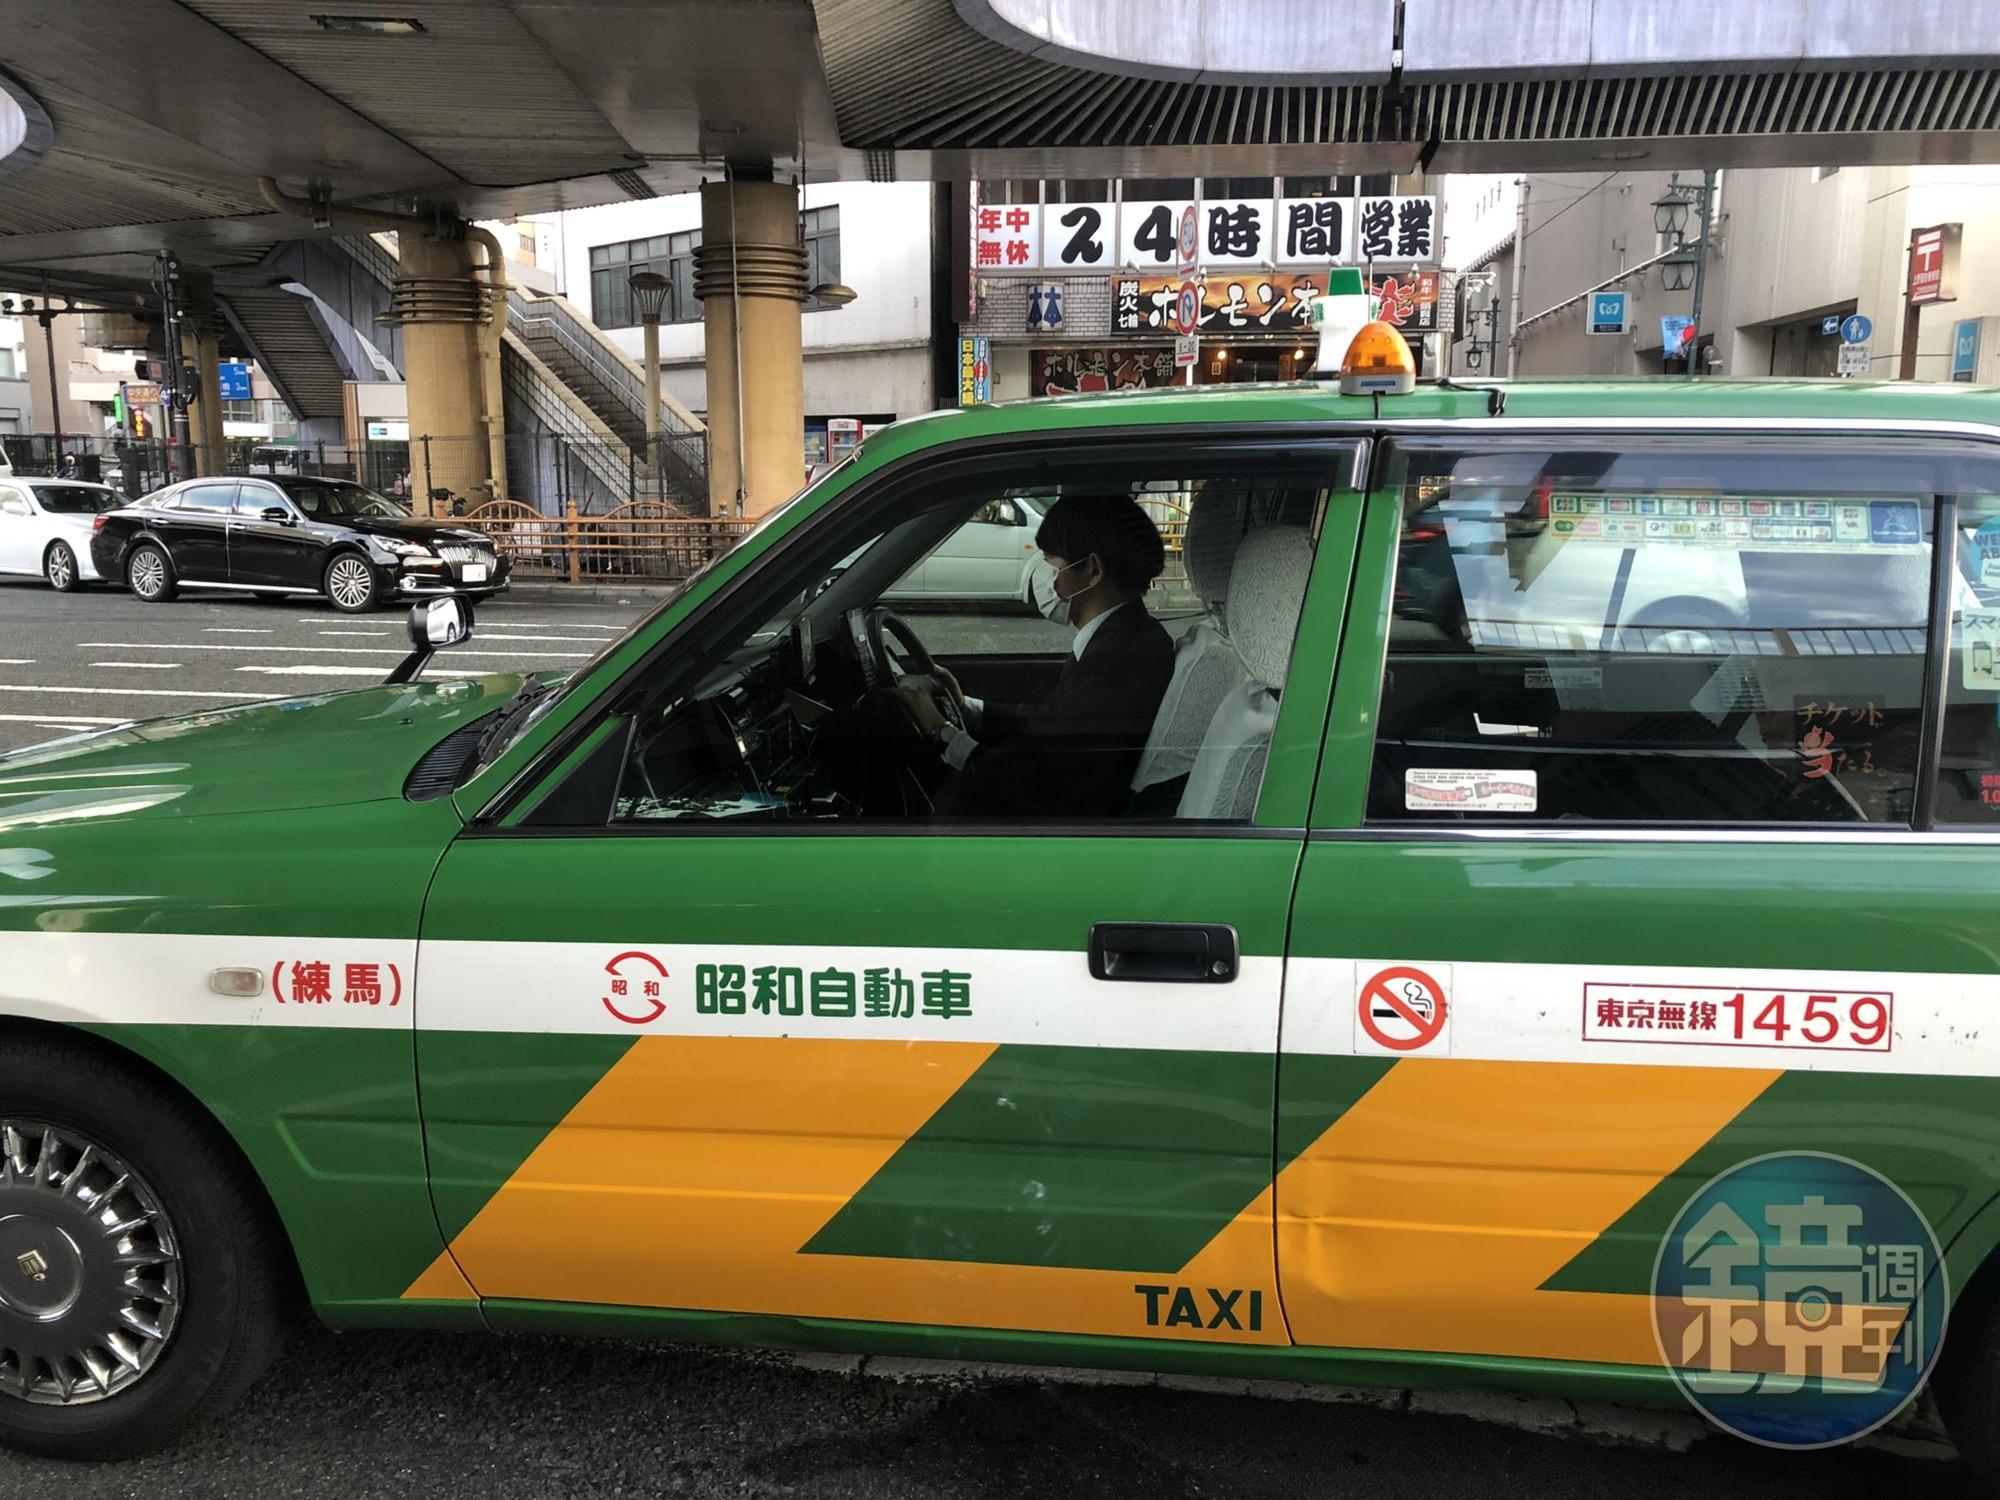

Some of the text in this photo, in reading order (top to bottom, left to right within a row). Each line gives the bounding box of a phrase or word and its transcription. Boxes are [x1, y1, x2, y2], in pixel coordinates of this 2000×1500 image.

[979, 208, 1030, 233] 年中
[1060, 199, 1433, 264] 24時間営業
[978, 240, 1030, 265] 無休
[1043, 351, 1174, 377] ホルモン本舗
[1974, 533, 2000, 546] WE
[1965, 614, 2000, 629] スマ
[271, 960, 402, 1006] (練馬)
[611, 979, 660, 996] 昭和
[695, 963, 973, 1019] 昭和自動車
[1134, 1284, 1262, 1331] TAXI
